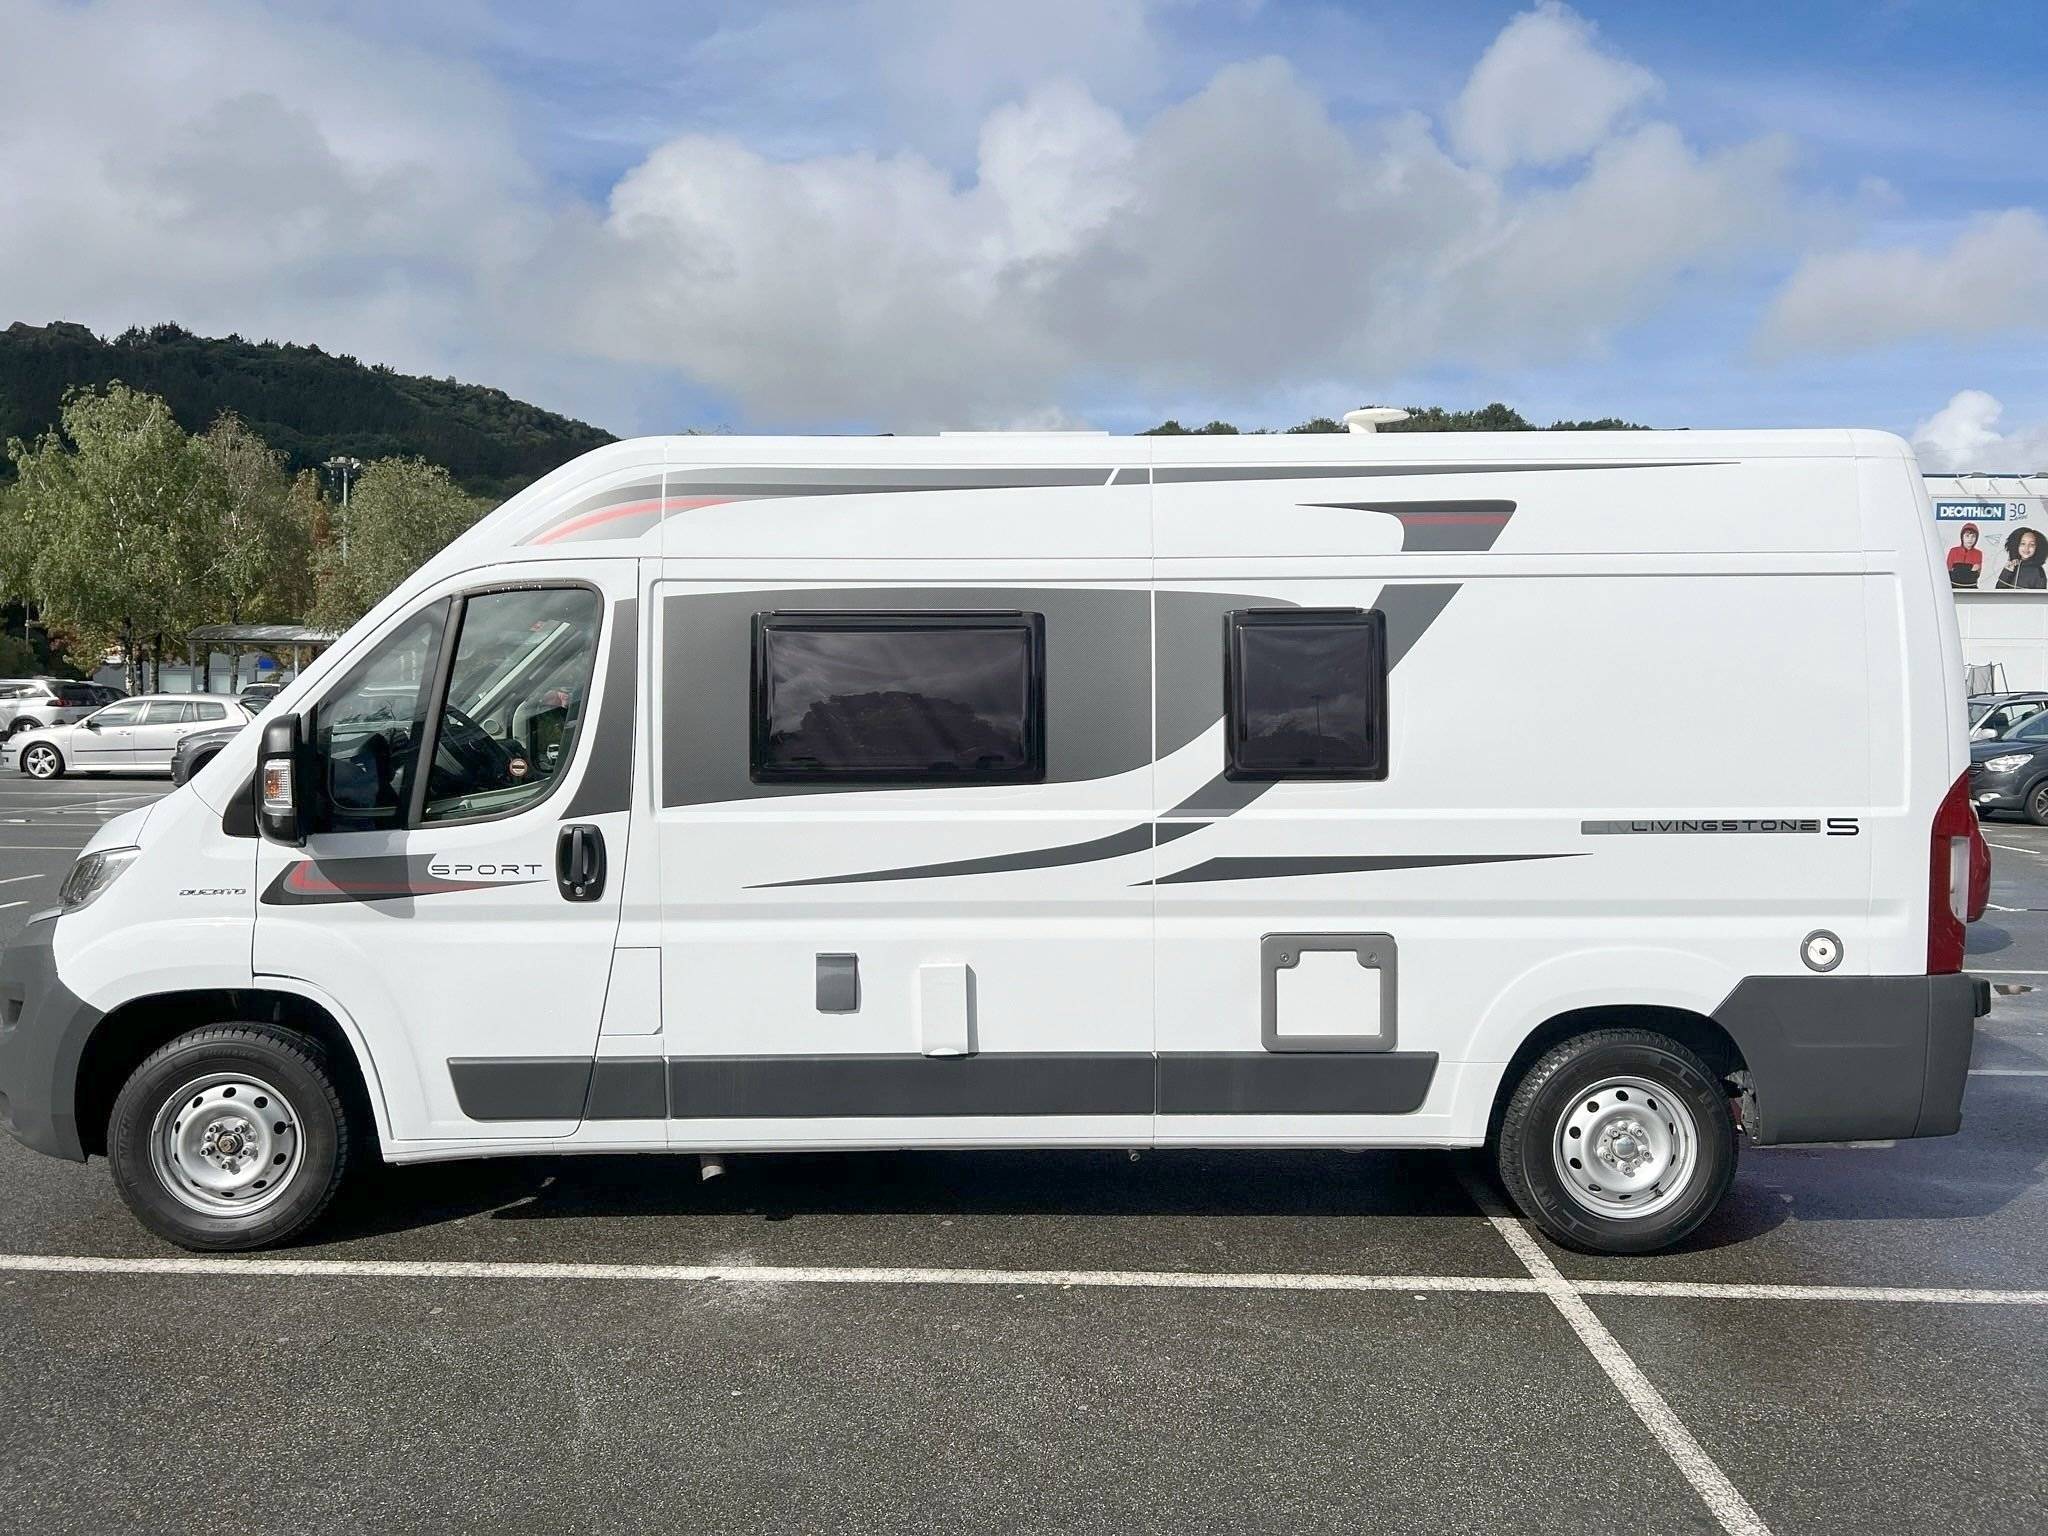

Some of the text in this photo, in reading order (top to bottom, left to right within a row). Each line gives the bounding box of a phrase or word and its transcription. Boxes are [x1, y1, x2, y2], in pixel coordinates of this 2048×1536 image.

[1940, 506, 2002, 518] DECATHLON
[1631, 819, 1818, 832] LIVINGSTONE
[431, 864, 543, 875] SPORT
[179, 888, 246, 896] DUCATO
